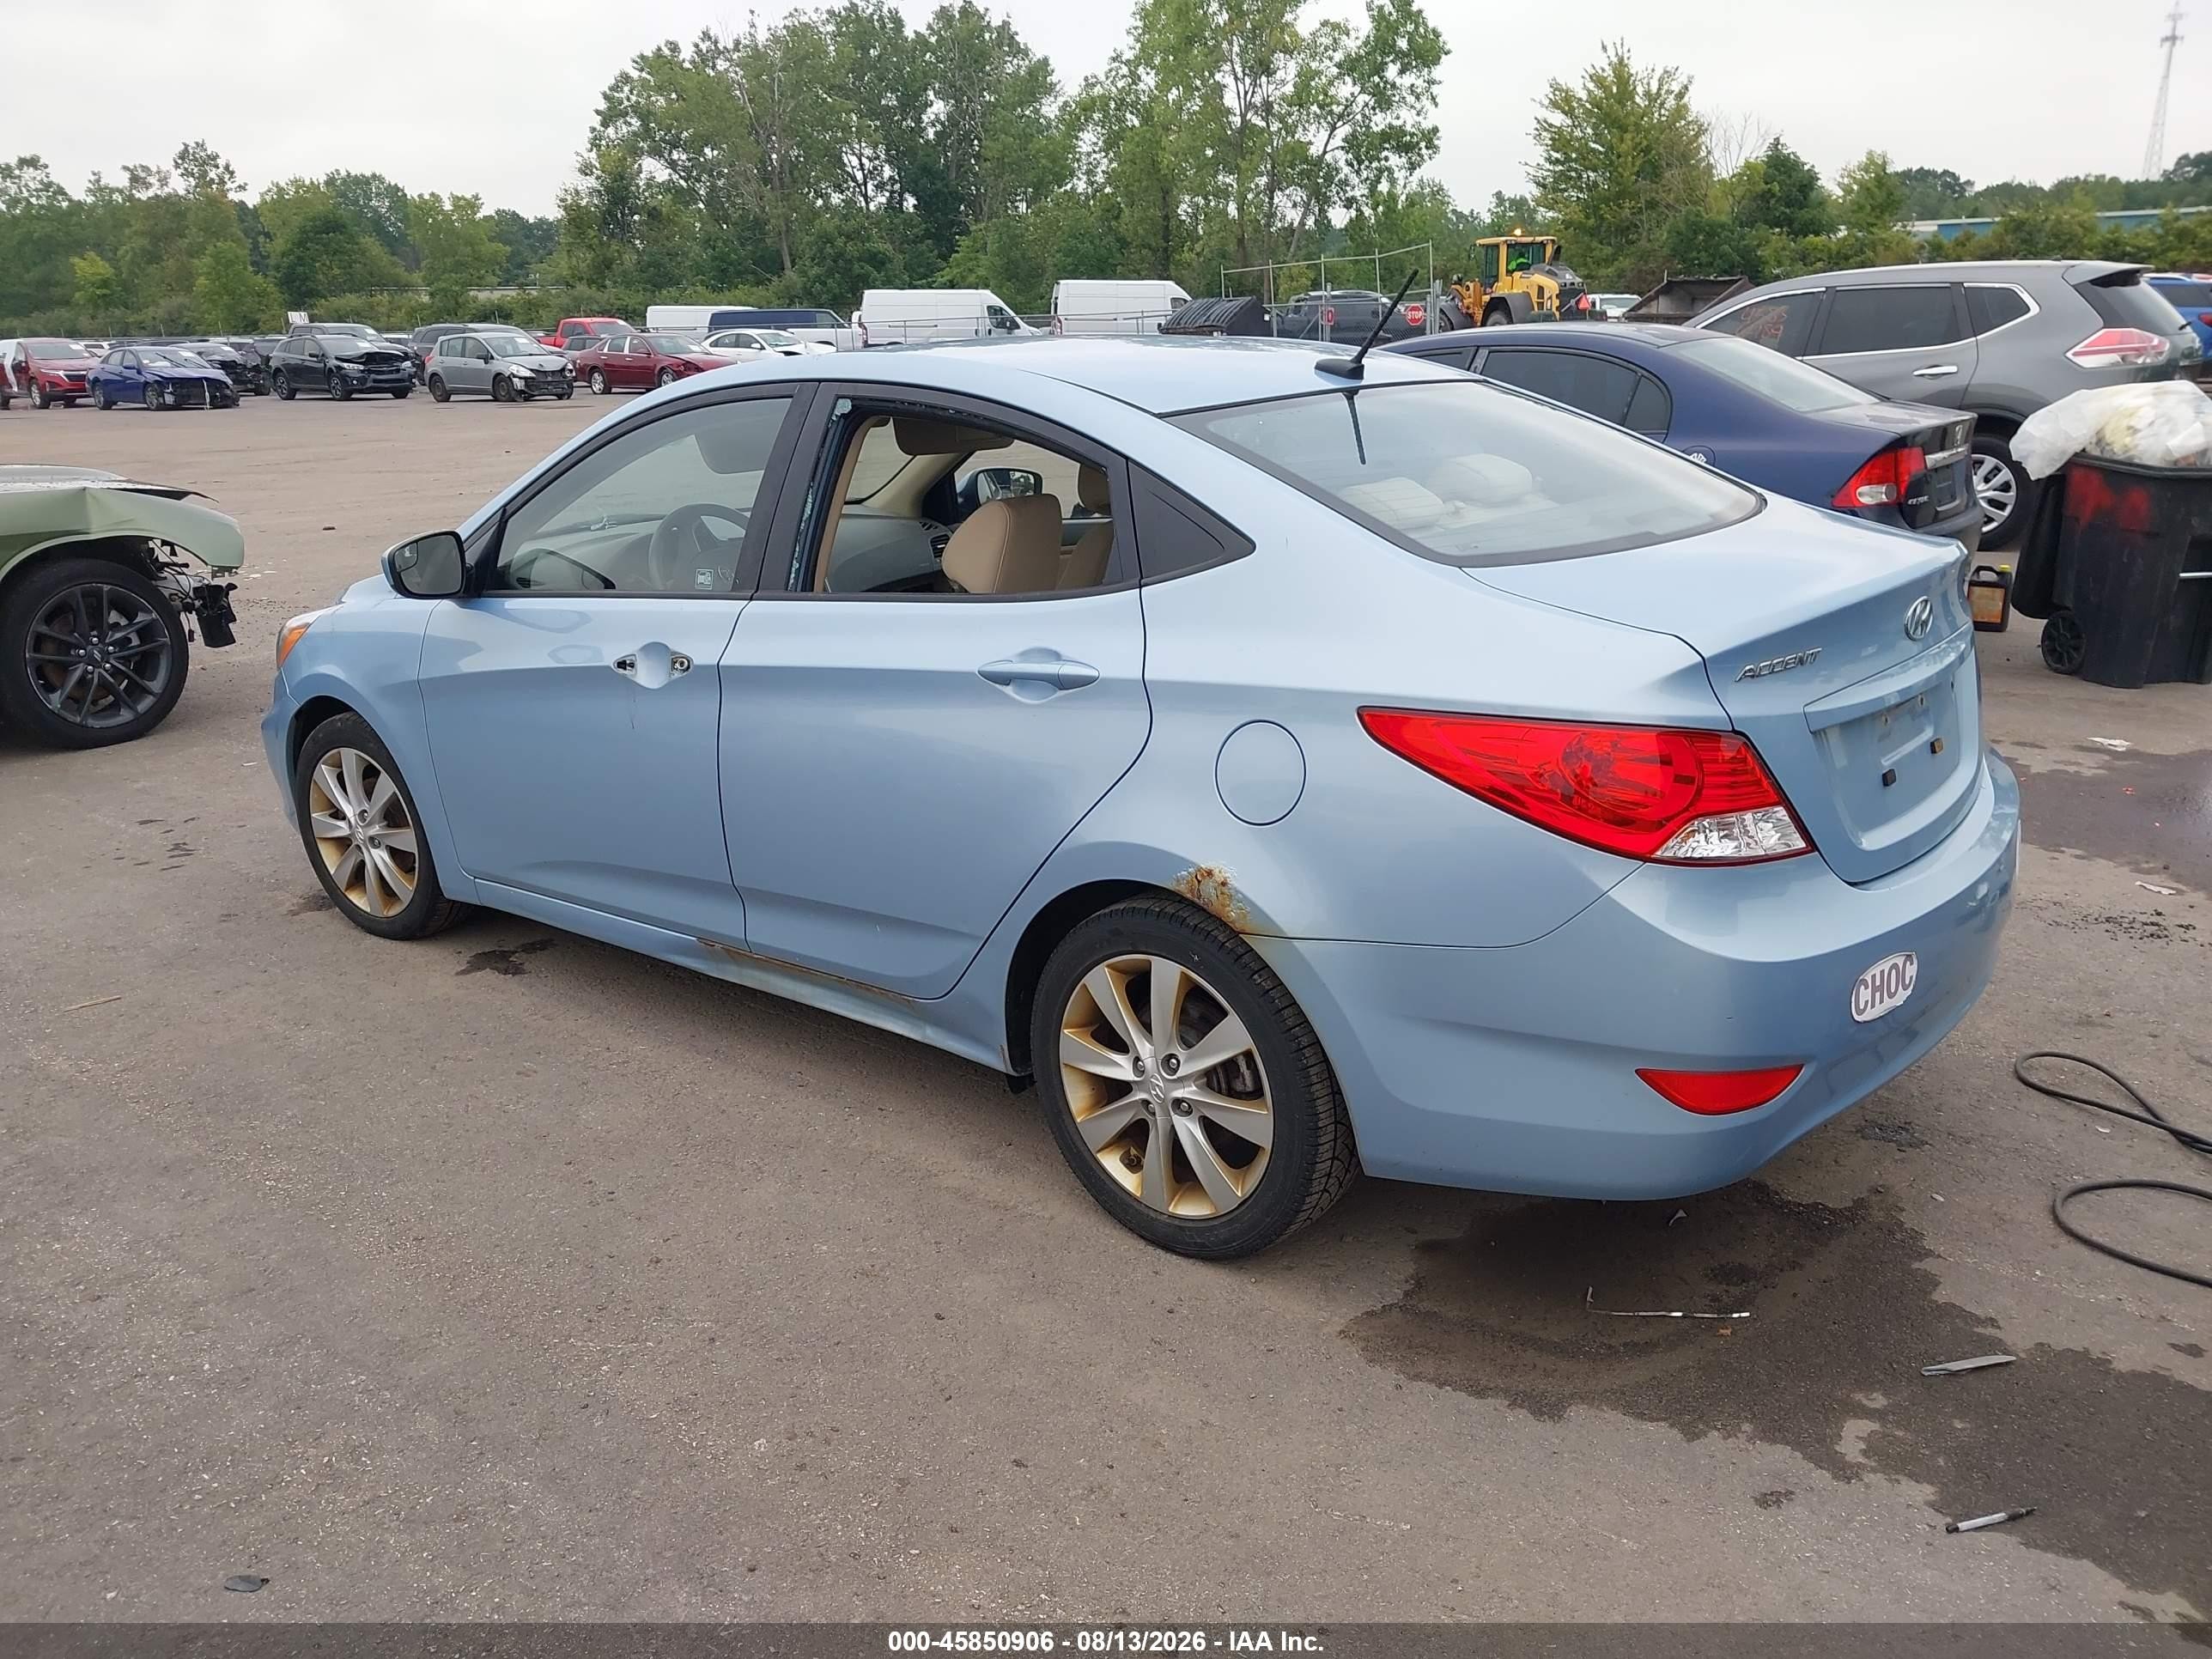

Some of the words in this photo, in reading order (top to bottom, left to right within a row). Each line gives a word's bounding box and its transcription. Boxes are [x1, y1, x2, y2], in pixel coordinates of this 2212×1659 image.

[1407, 310, 1423, 319] STOP
[1735, 647, 1823, 683] ACCENT
[1854, 954, 1914, 1017] CHOC
